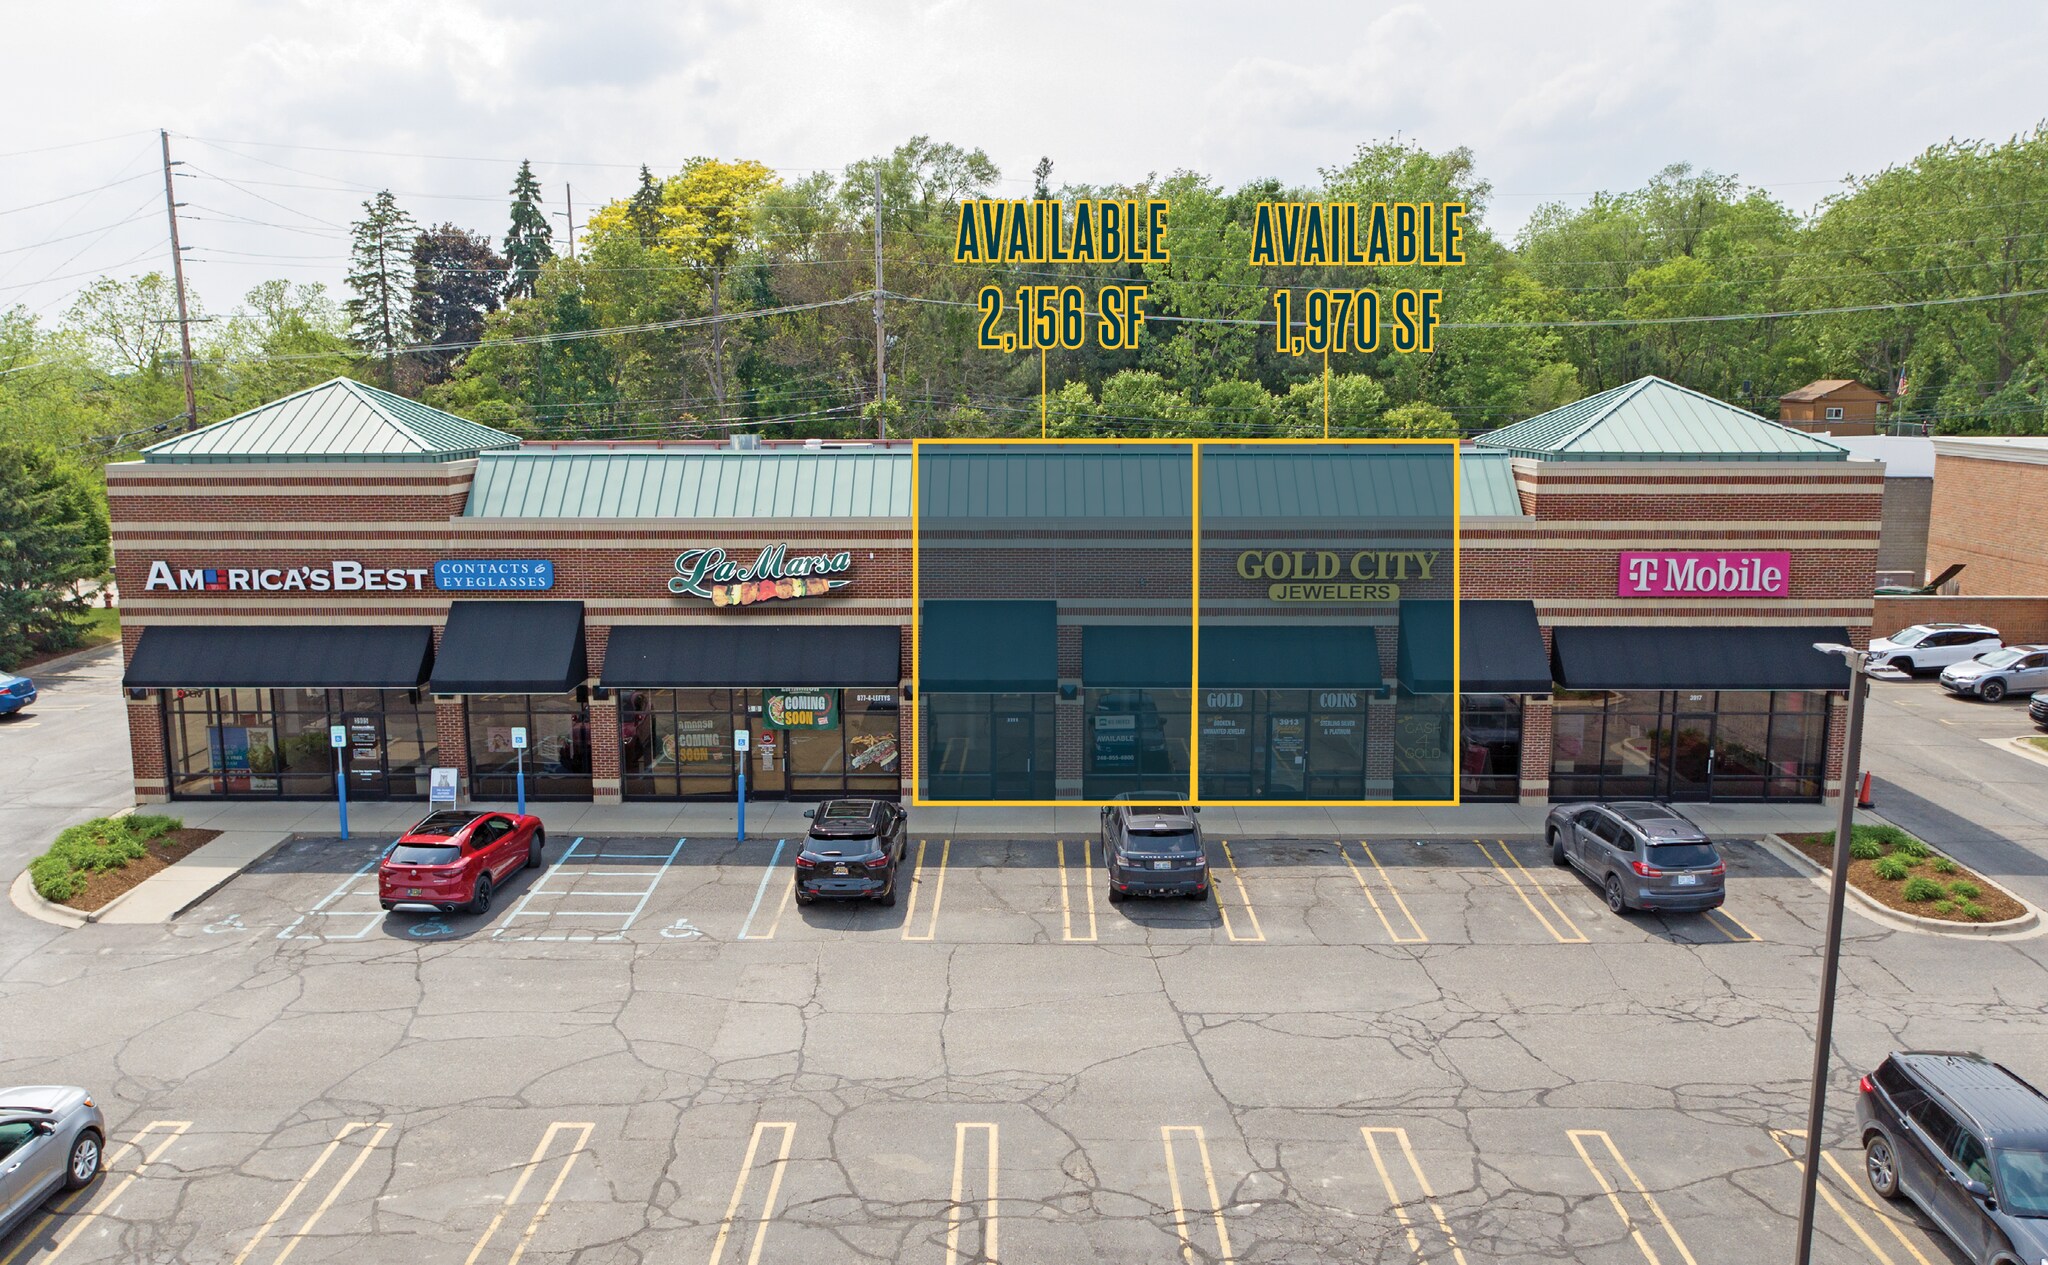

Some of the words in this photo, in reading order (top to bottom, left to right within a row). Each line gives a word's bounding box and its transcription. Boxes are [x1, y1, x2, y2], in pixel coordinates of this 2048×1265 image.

[440, 563, 529, 574] CONTACTS
[534, 563, 546, 574] &
[668, 547, 736, 598] La
[737, 543, 851, 580] Marsa
[1236, 550, 1341, 580] GOLD
[1350, 550, 1440, 580] CITY
[443, 576, 546, 587] EYEGLASSES
[1663, 558, 1782, 592] Mobile
[1276, 585, 1391, 600] JEWELERS
[785, 696, 826, 711] COMING
[856, 694, 891, 702] 877-4-LEFTYS
[1207, 692, 1243, 708] GOLD
[1319, 692, 1357, 708] COINS
[785, 711, 813, 725] SOON
[1405, 722, 1442, 734] CASH
[679, 734, 719, 747] COMING
[1415, 734, 1431, 748] 4
[680, 747, 708, 761] SOON
[1405, 747, 1441, 759] GOLD
